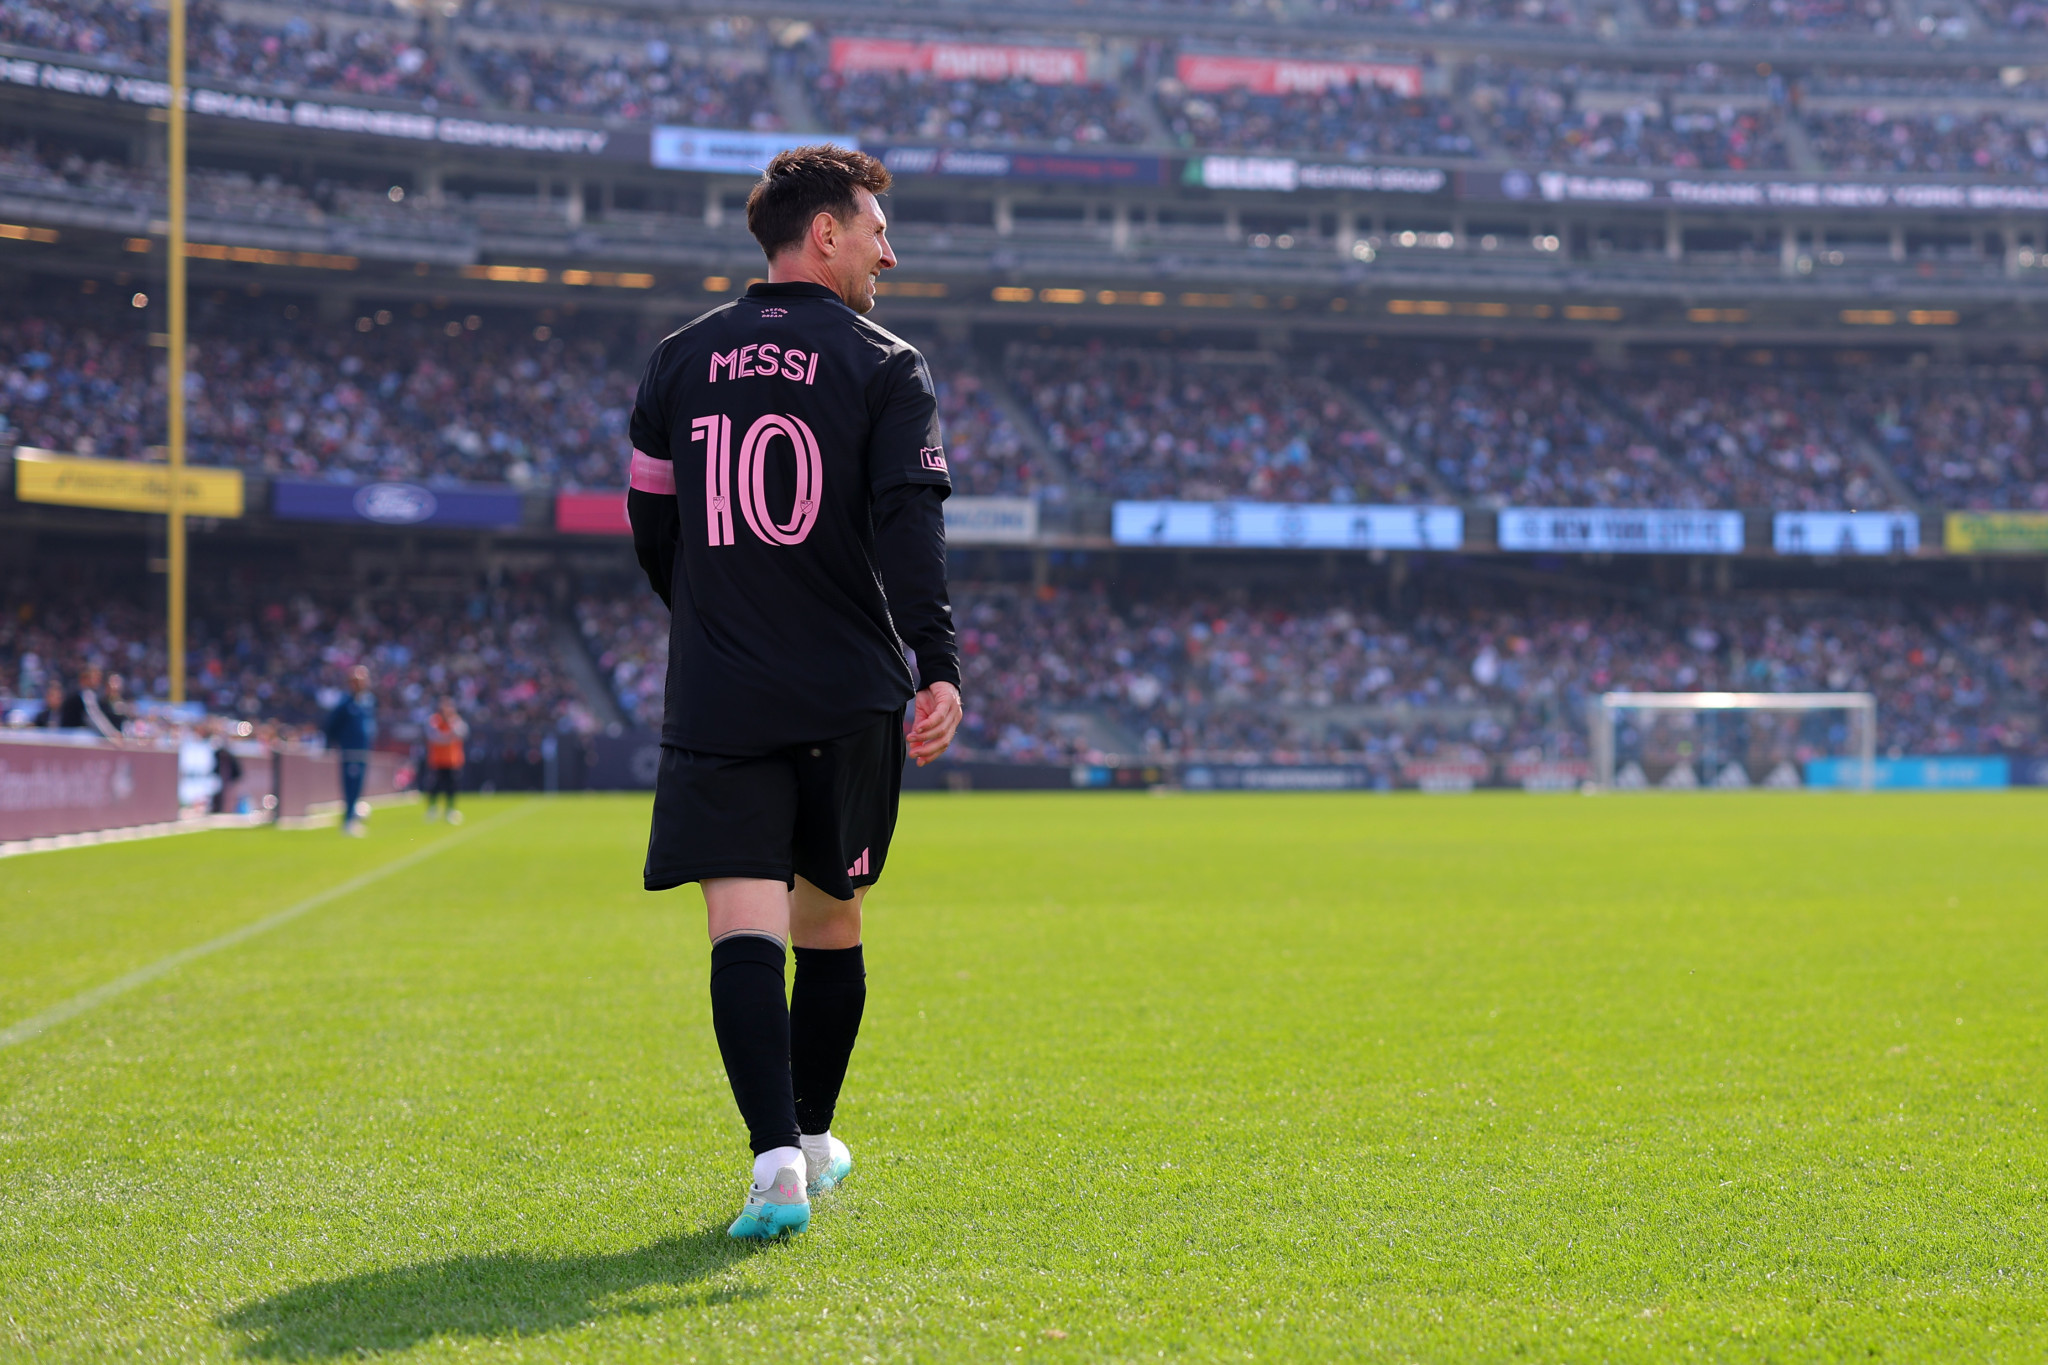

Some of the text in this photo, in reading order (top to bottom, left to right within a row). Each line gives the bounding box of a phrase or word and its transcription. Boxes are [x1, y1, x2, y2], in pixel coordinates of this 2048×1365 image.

[41, 64, 111, 97] NEW
[193, 89, 290, 123] SMALL
[294, 102, 436, 140] BUSINESS
[439, 117, 608, 153] COMMUNITY
[1669, 181, 1761, 204] THANK
[1769, 182, 1819, 207] THE
[1824, 183, 1887, 208] NEW
[1895, 184, 1964, 208] YORK
[709, 343, 819, 385] MESSI
[691, 413, 823, 546] 10
